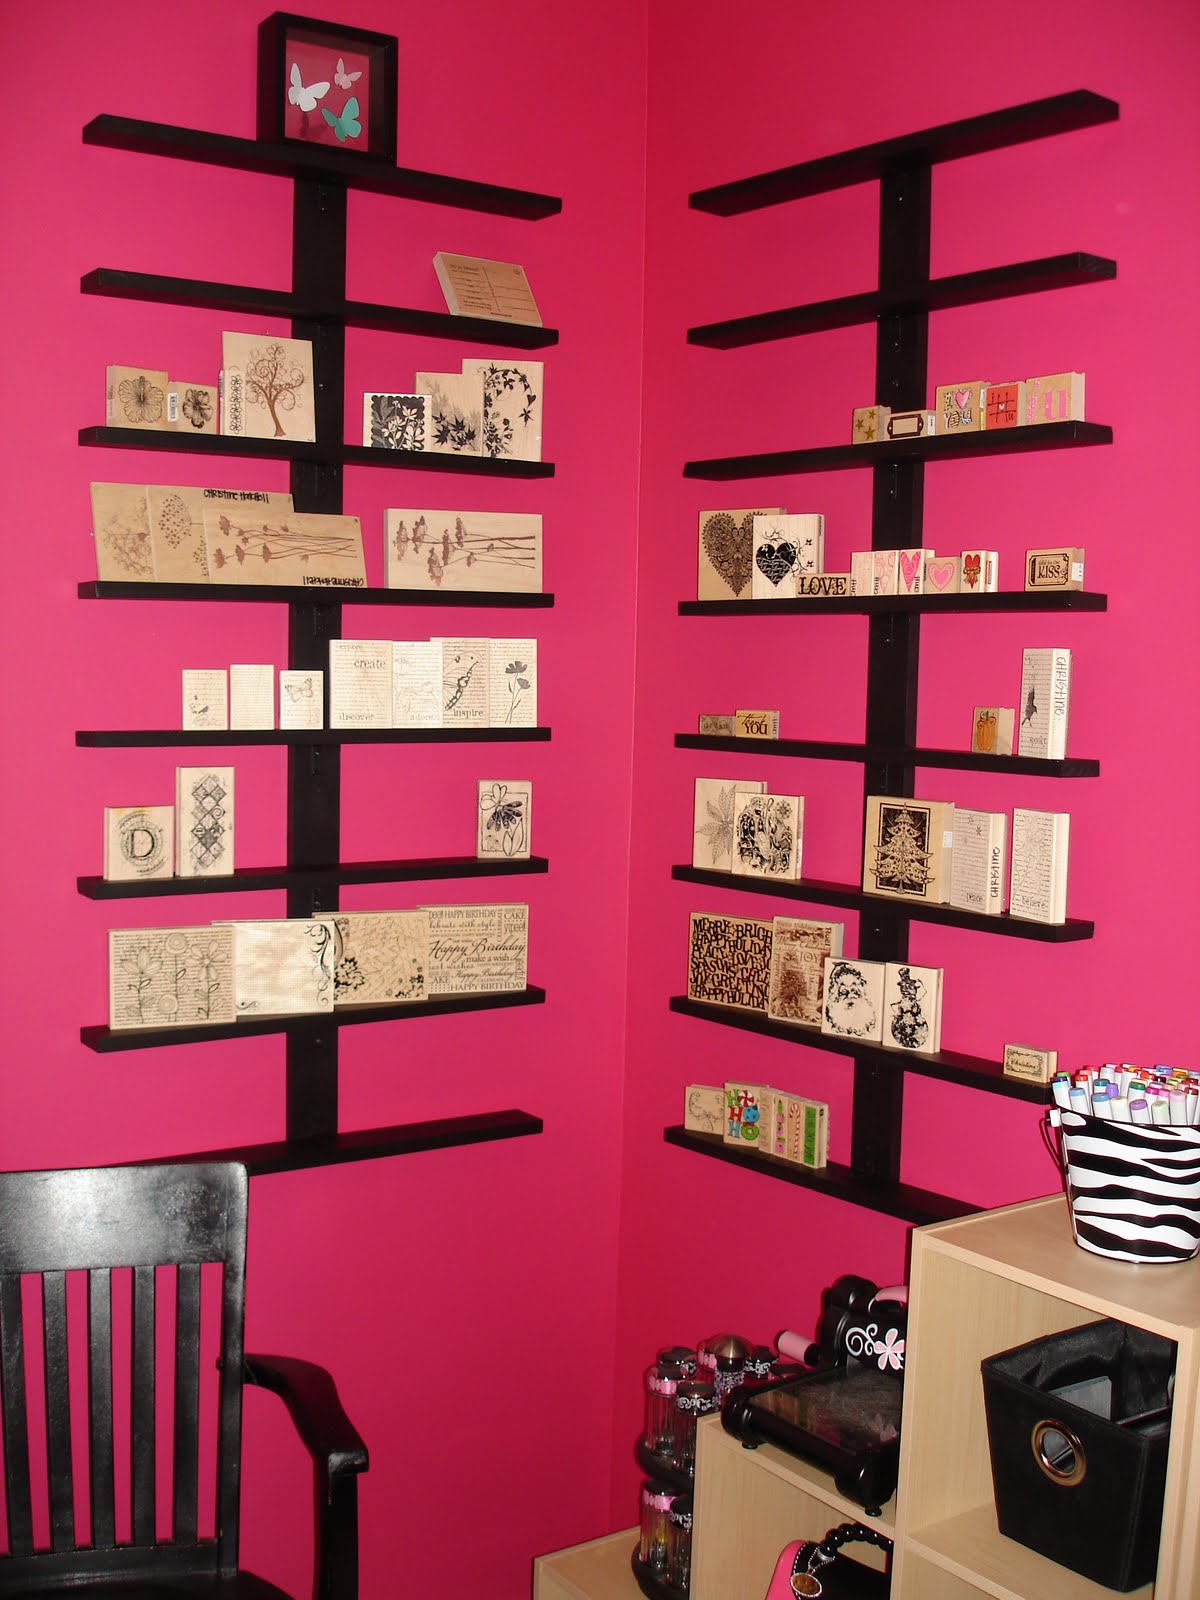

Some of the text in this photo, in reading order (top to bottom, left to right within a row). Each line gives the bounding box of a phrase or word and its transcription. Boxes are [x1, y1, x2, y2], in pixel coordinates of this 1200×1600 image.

[1037, 565, 1061, 579] KISS
[798, 576, 847, 595] LOVE
[353, 660, 386, 669] create
[453, 708, 484, 719] inspire
[744, 723, 768, 735] YOU
[130, 828, 155, 859] D
[465, 909, 497, 919] BIRTHDAY
[503, 912, 526, 920] CAKE
[692, 917, 731, 935] MERRY
[697, 931, 731, 949] HAPPY
[428, 936, 526, 963] Happy Birthday
[691, 943, 729, 960] PEACE
[799, 951, 821, 963] JOY
[450, 980, 525, 992] HAPPY BIRTHDAY
[693, 983, 727, 1003] HAPPY
